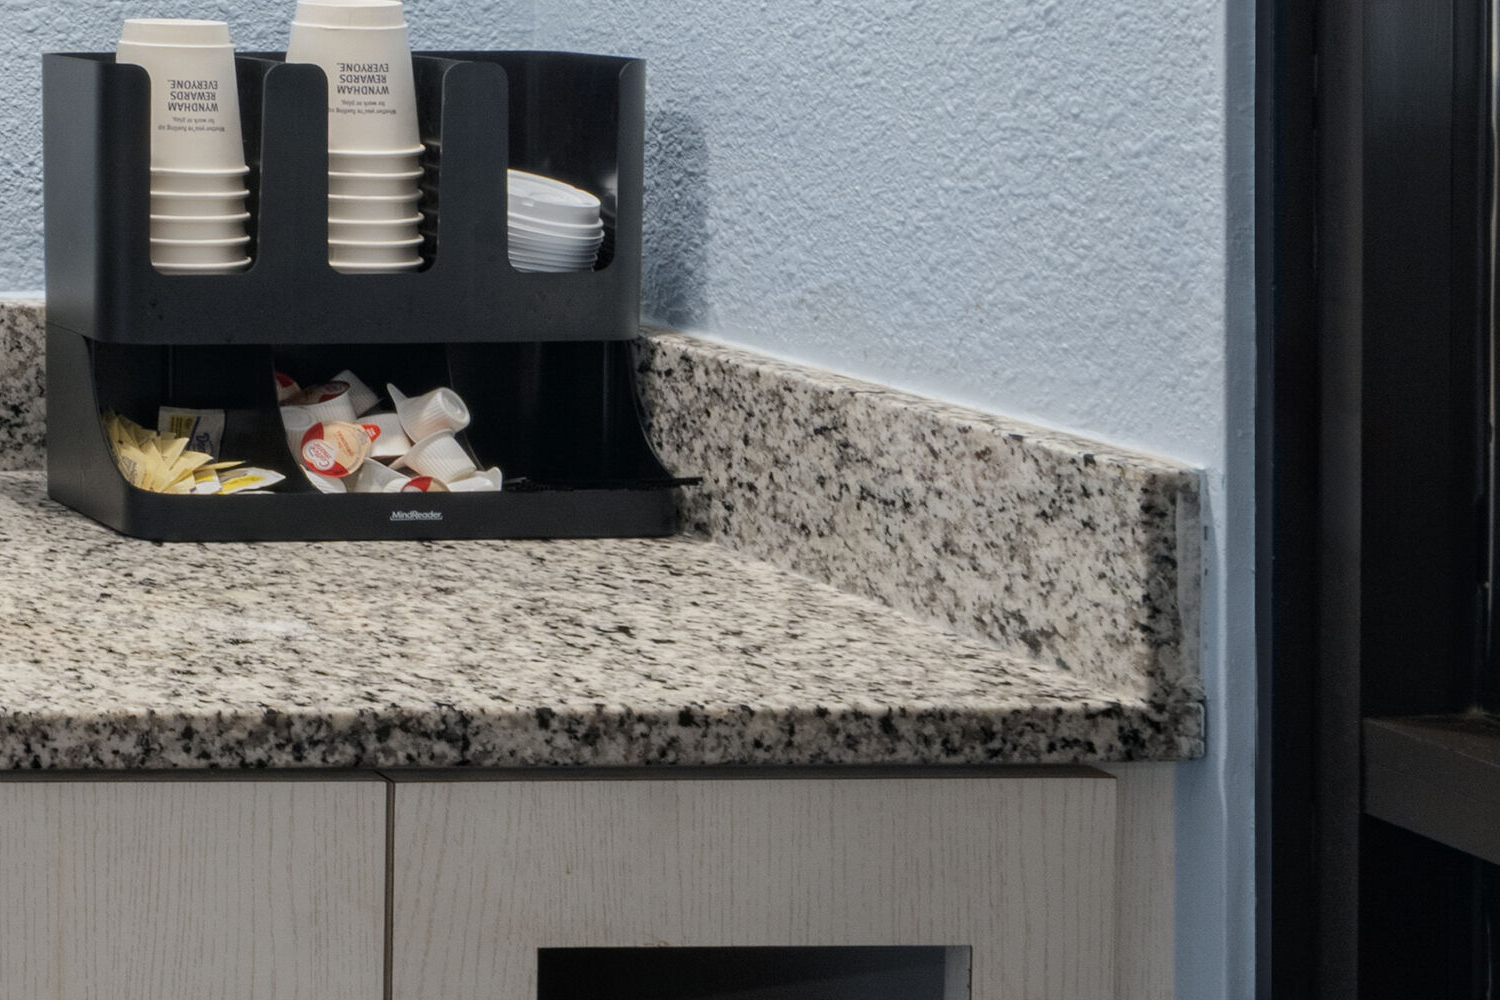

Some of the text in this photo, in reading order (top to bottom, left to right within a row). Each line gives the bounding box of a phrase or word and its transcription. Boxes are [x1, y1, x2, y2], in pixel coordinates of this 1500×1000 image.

[336, 62, 389, 73] EVERYONE.
[339, 74, 387, 84] REWARDS
[167, 79, 219, 90] EVERYONE.
[336, 85, 390, 95] WYNDHAM
[170, 91, 217, 101] REWARDS
[167, 102, 219, 112] WYNDHAM
